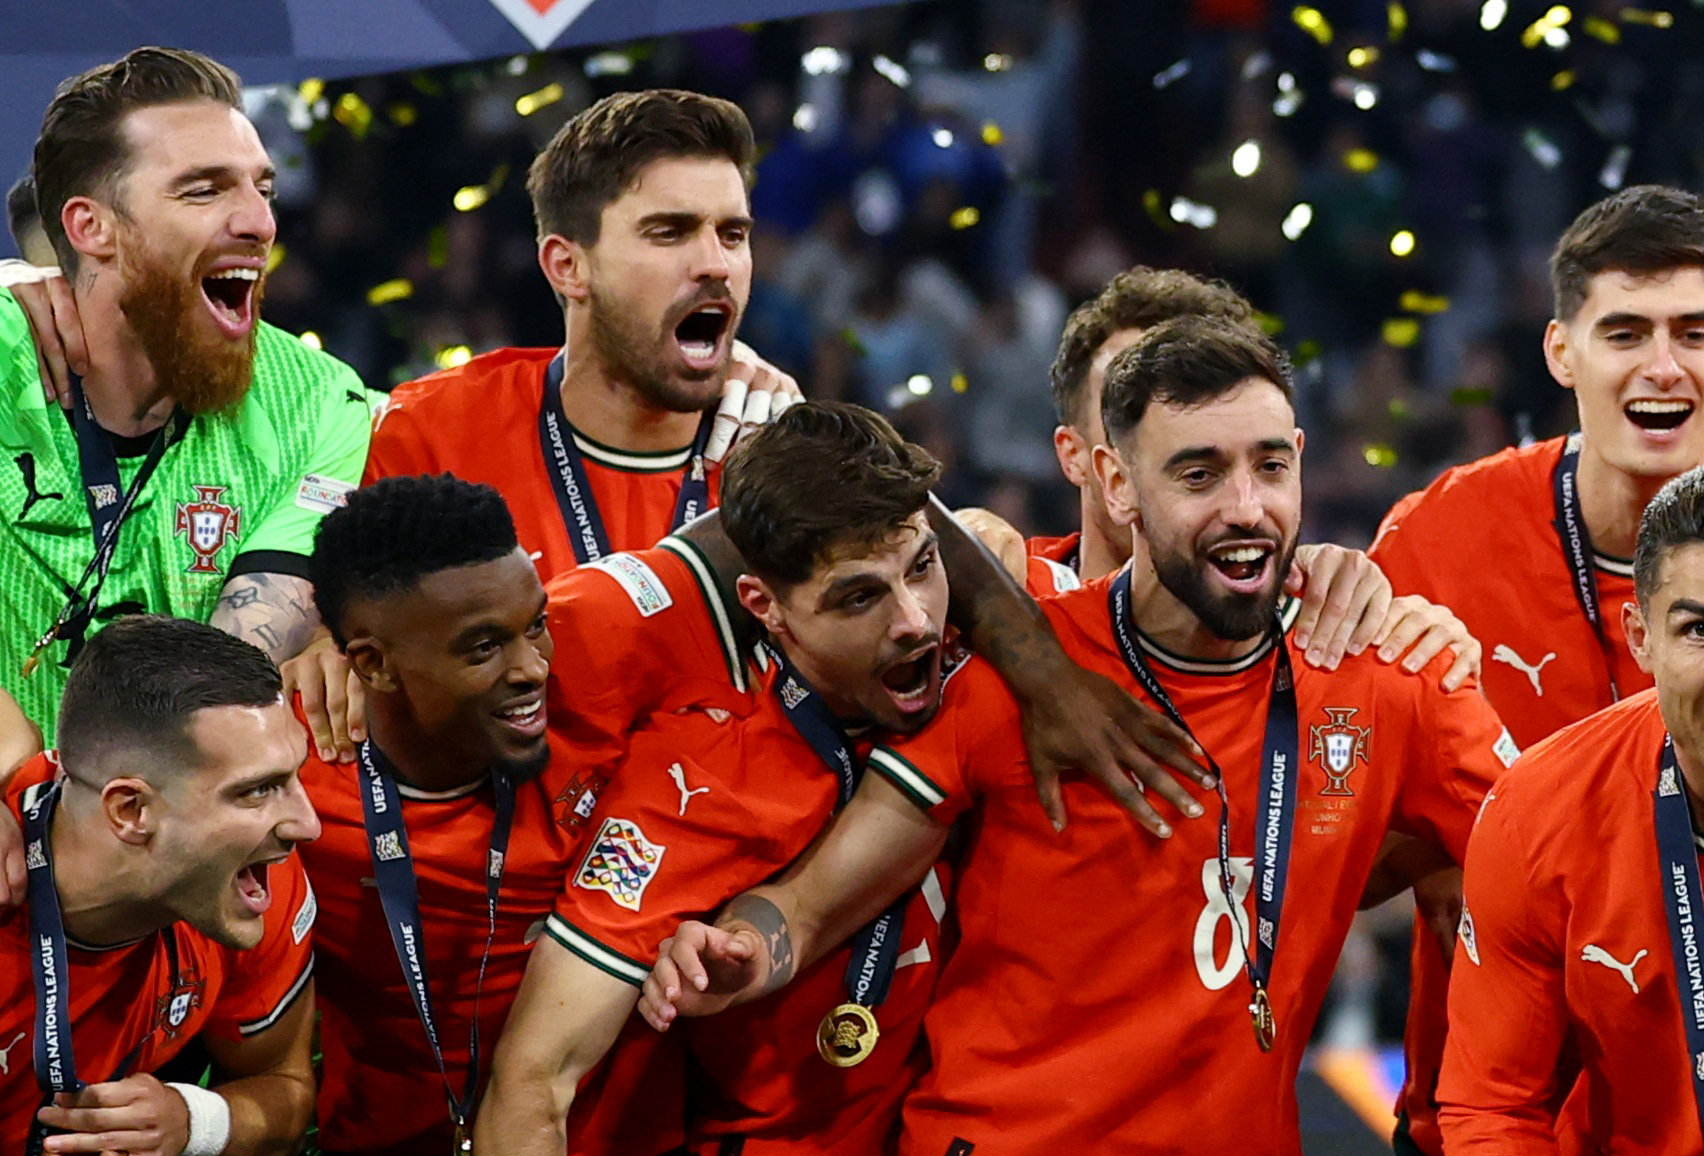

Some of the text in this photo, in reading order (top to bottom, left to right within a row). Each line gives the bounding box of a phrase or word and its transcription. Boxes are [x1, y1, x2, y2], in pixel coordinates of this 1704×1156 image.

[547, 411, 570, 466] LEAGUE
[561, 463, 590, 527] NATIONS
[1562, 471, 1597, 624] UEFA NATIONS LEAGUE
[1117, 624, 1147, 680] NATIONS
[361, 737, 388, 813] UEFA NATI
[1262, 750, 1286, 902] UEFA NATIONS LEAGUE
[1194, 857, 1254, 990] 8
[1671, 861, 1692, 923] LEAGUE
[400, 921, 423, 982] LEAGUE
[855, 948, 878, 1003] NATION
[1681, 923, 1703, 991] NATIONS
[40, 934, 64, 1091] UEFA NATIONS LEAGUE
